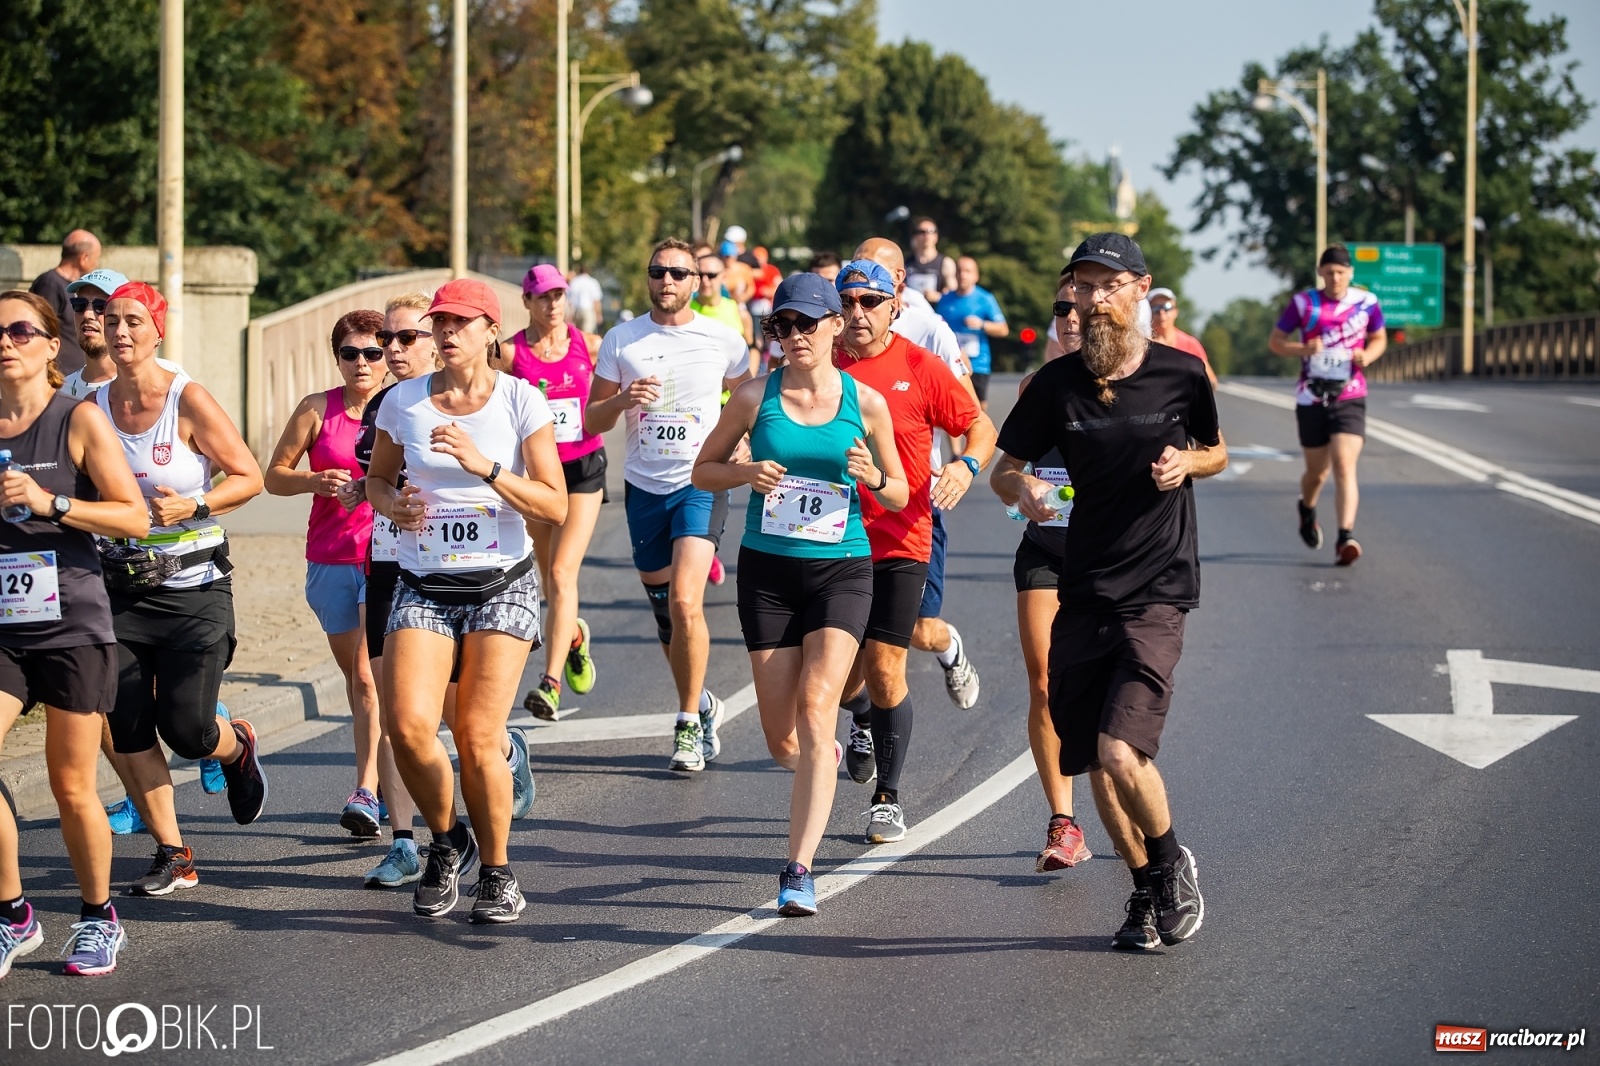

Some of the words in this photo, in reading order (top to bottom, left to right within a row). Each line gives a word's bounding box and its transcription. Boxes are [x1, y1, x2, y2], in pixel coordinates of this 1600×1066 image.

[657, 425, 686, 441] 208
[799, 494, 823, 516] 18
[440, 521, 479, 543] 108
